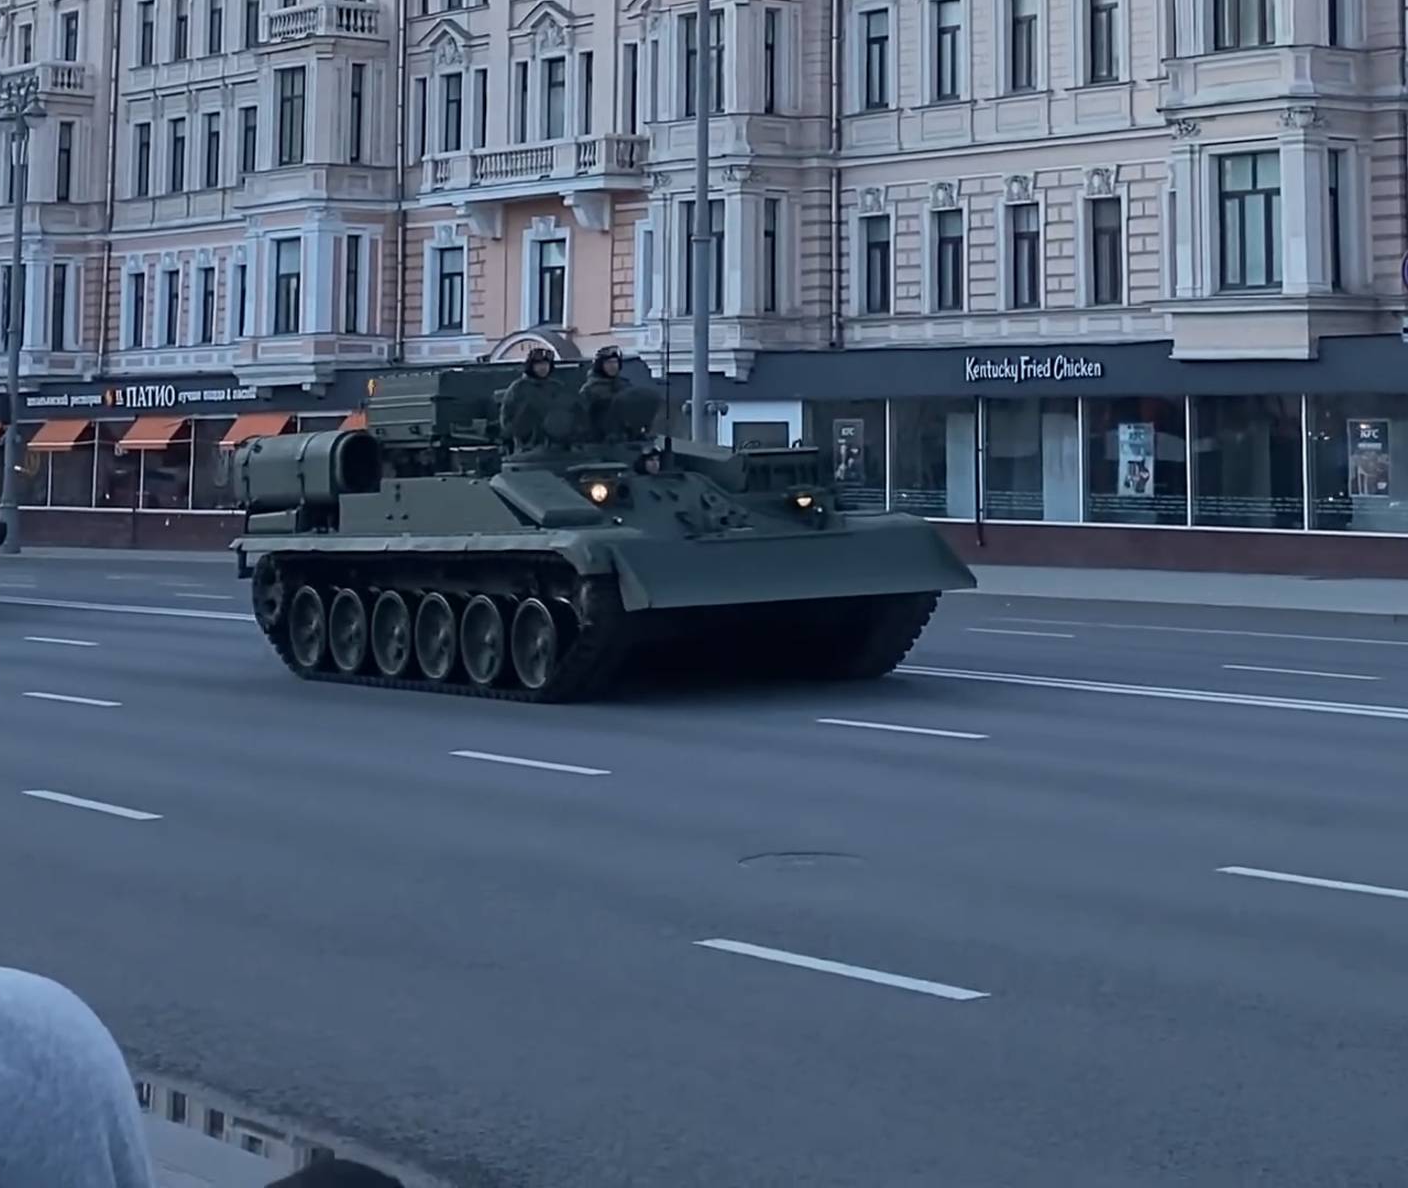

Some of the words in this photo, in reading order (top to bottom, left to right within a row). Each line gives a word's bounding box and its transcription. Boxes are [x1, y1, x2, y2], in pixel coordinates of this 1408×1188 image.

[965, 355, 1018, 383] Kentucky
[1020, 355, 1051, 380] Fried
[1053, 354, 1102, 381] Chicken
[126, 384, 176, 408] ПАТИО
